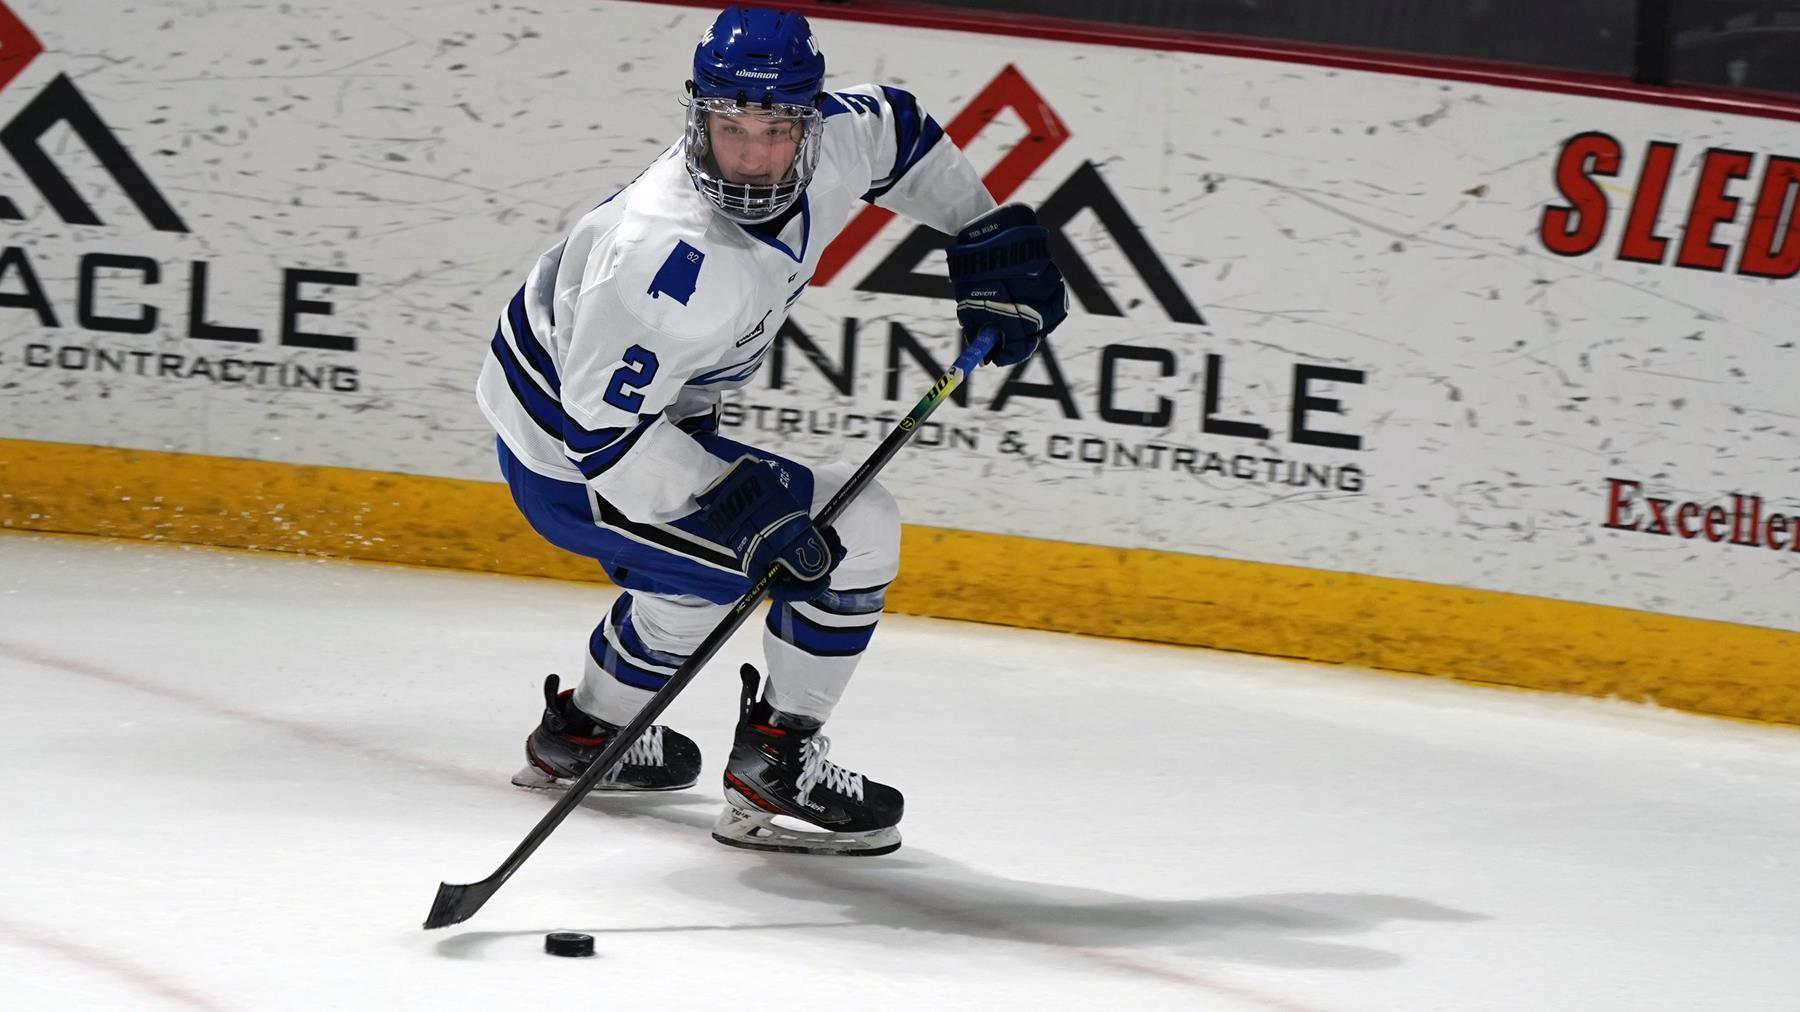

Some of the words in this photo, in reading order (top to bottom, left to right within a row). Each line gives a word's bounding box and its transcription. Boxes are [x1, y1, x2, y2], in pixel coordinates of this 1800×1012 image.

[736, 69, 779, 80] WARRIOR
[1540, 131, 1800, 279] SLED
[686, 251, 700, 264] 82
[24, 343, 360, 393] CONTRACTING
[603, 343, 660, 414] 2
[720, 402, 980, 450] STRUCTON
[997, 429, 1028, 455] &
[1048, 434, 1365, 493] CONTRACTING
